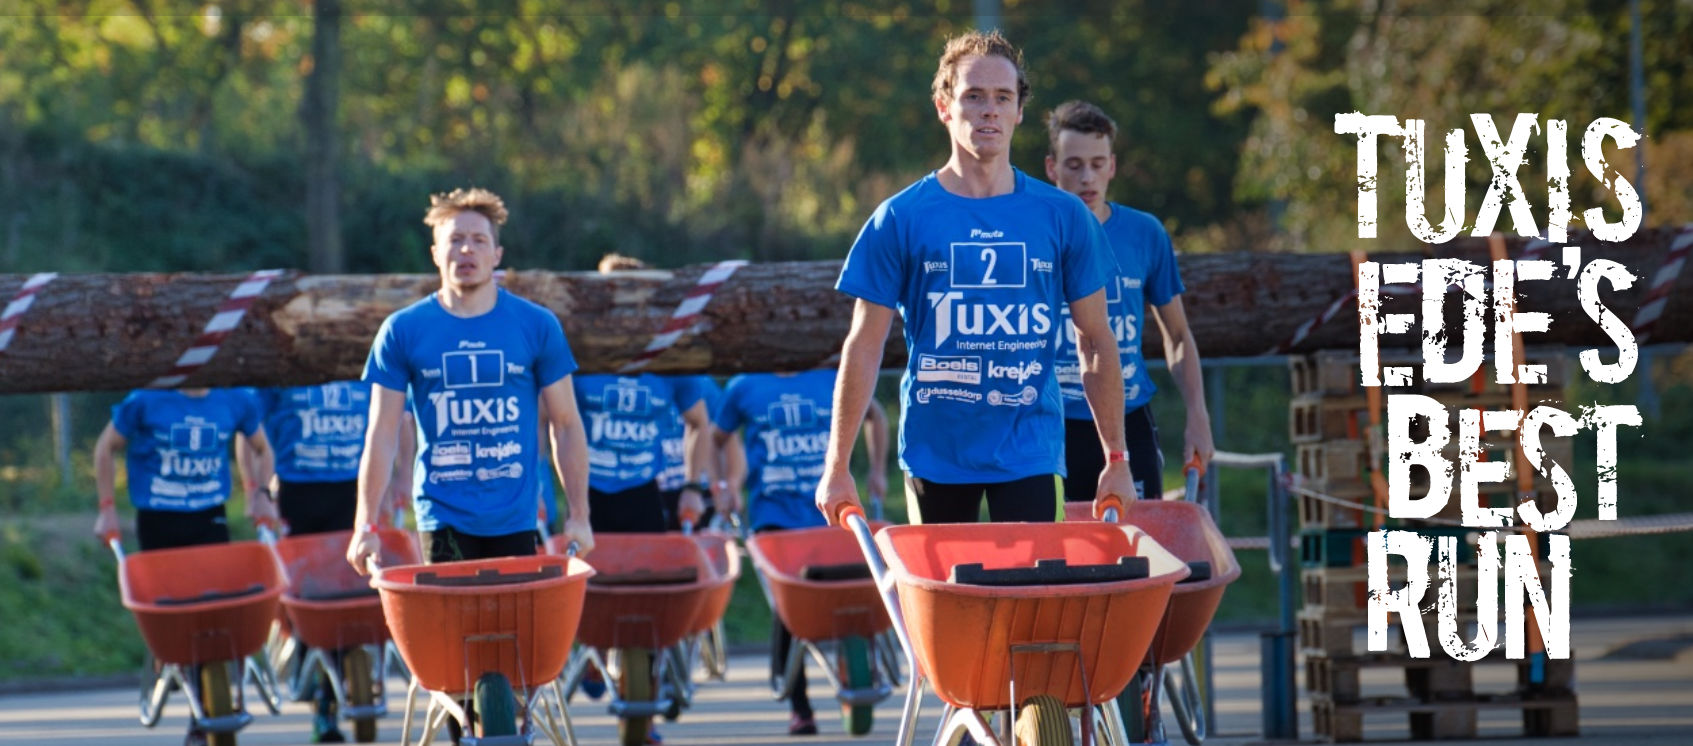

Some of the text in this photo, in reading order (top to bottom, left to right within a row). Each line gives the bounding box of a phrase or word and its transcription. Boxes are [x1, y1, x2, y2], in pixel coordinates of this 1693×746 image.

[981, 248, 997, 284] 2
[927, 291, 1051, 350] Tuxis
[957, 340, 996, 350] Internet
[469, 355, 477, 383] 1
[921, 357, 978, 371] Boels
[428, 390, 520, 438] Tuxis
[587, 411, 658, 442] Tuxis
